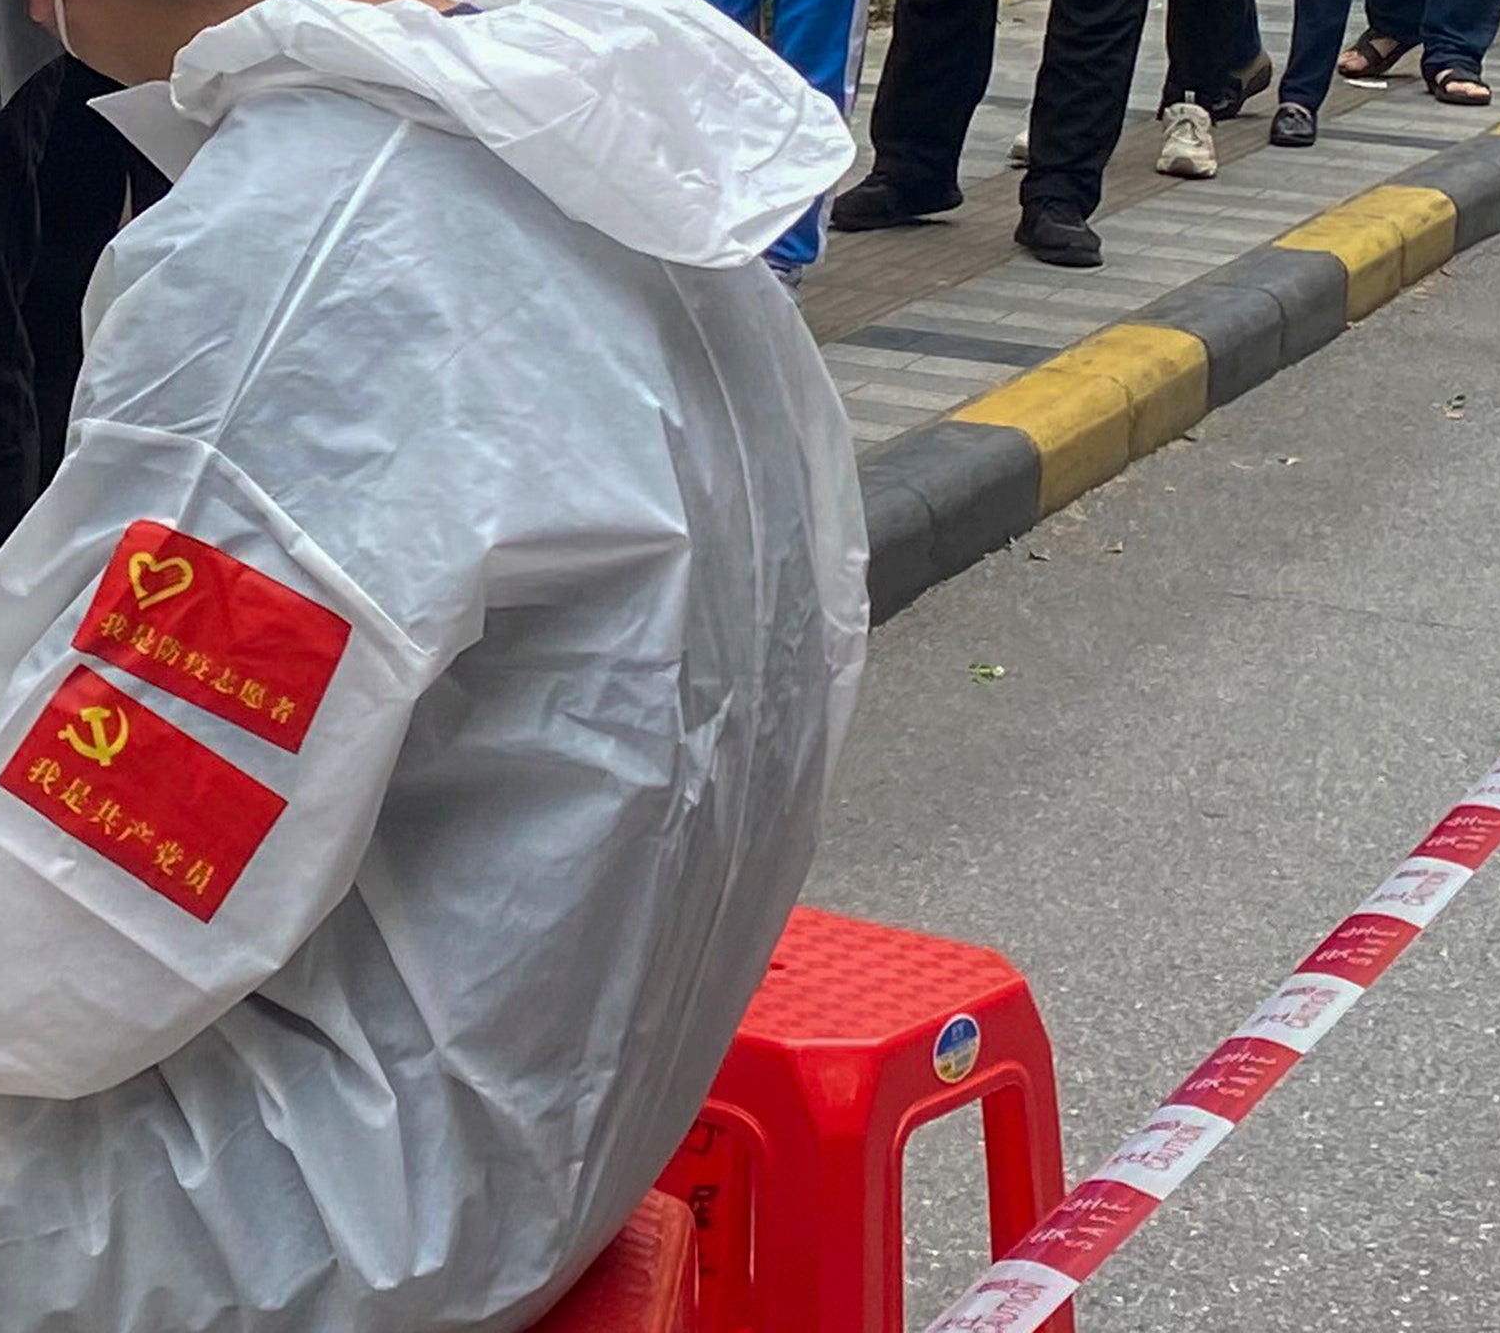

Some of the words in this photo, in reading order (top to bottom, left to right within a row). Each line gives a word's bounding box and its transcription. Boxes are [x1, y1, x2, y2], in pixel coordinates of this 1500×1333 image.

[100, 612, 297, 724] 我是防疫志愿者
[27, 756, 215, 895] 我是共产党员
